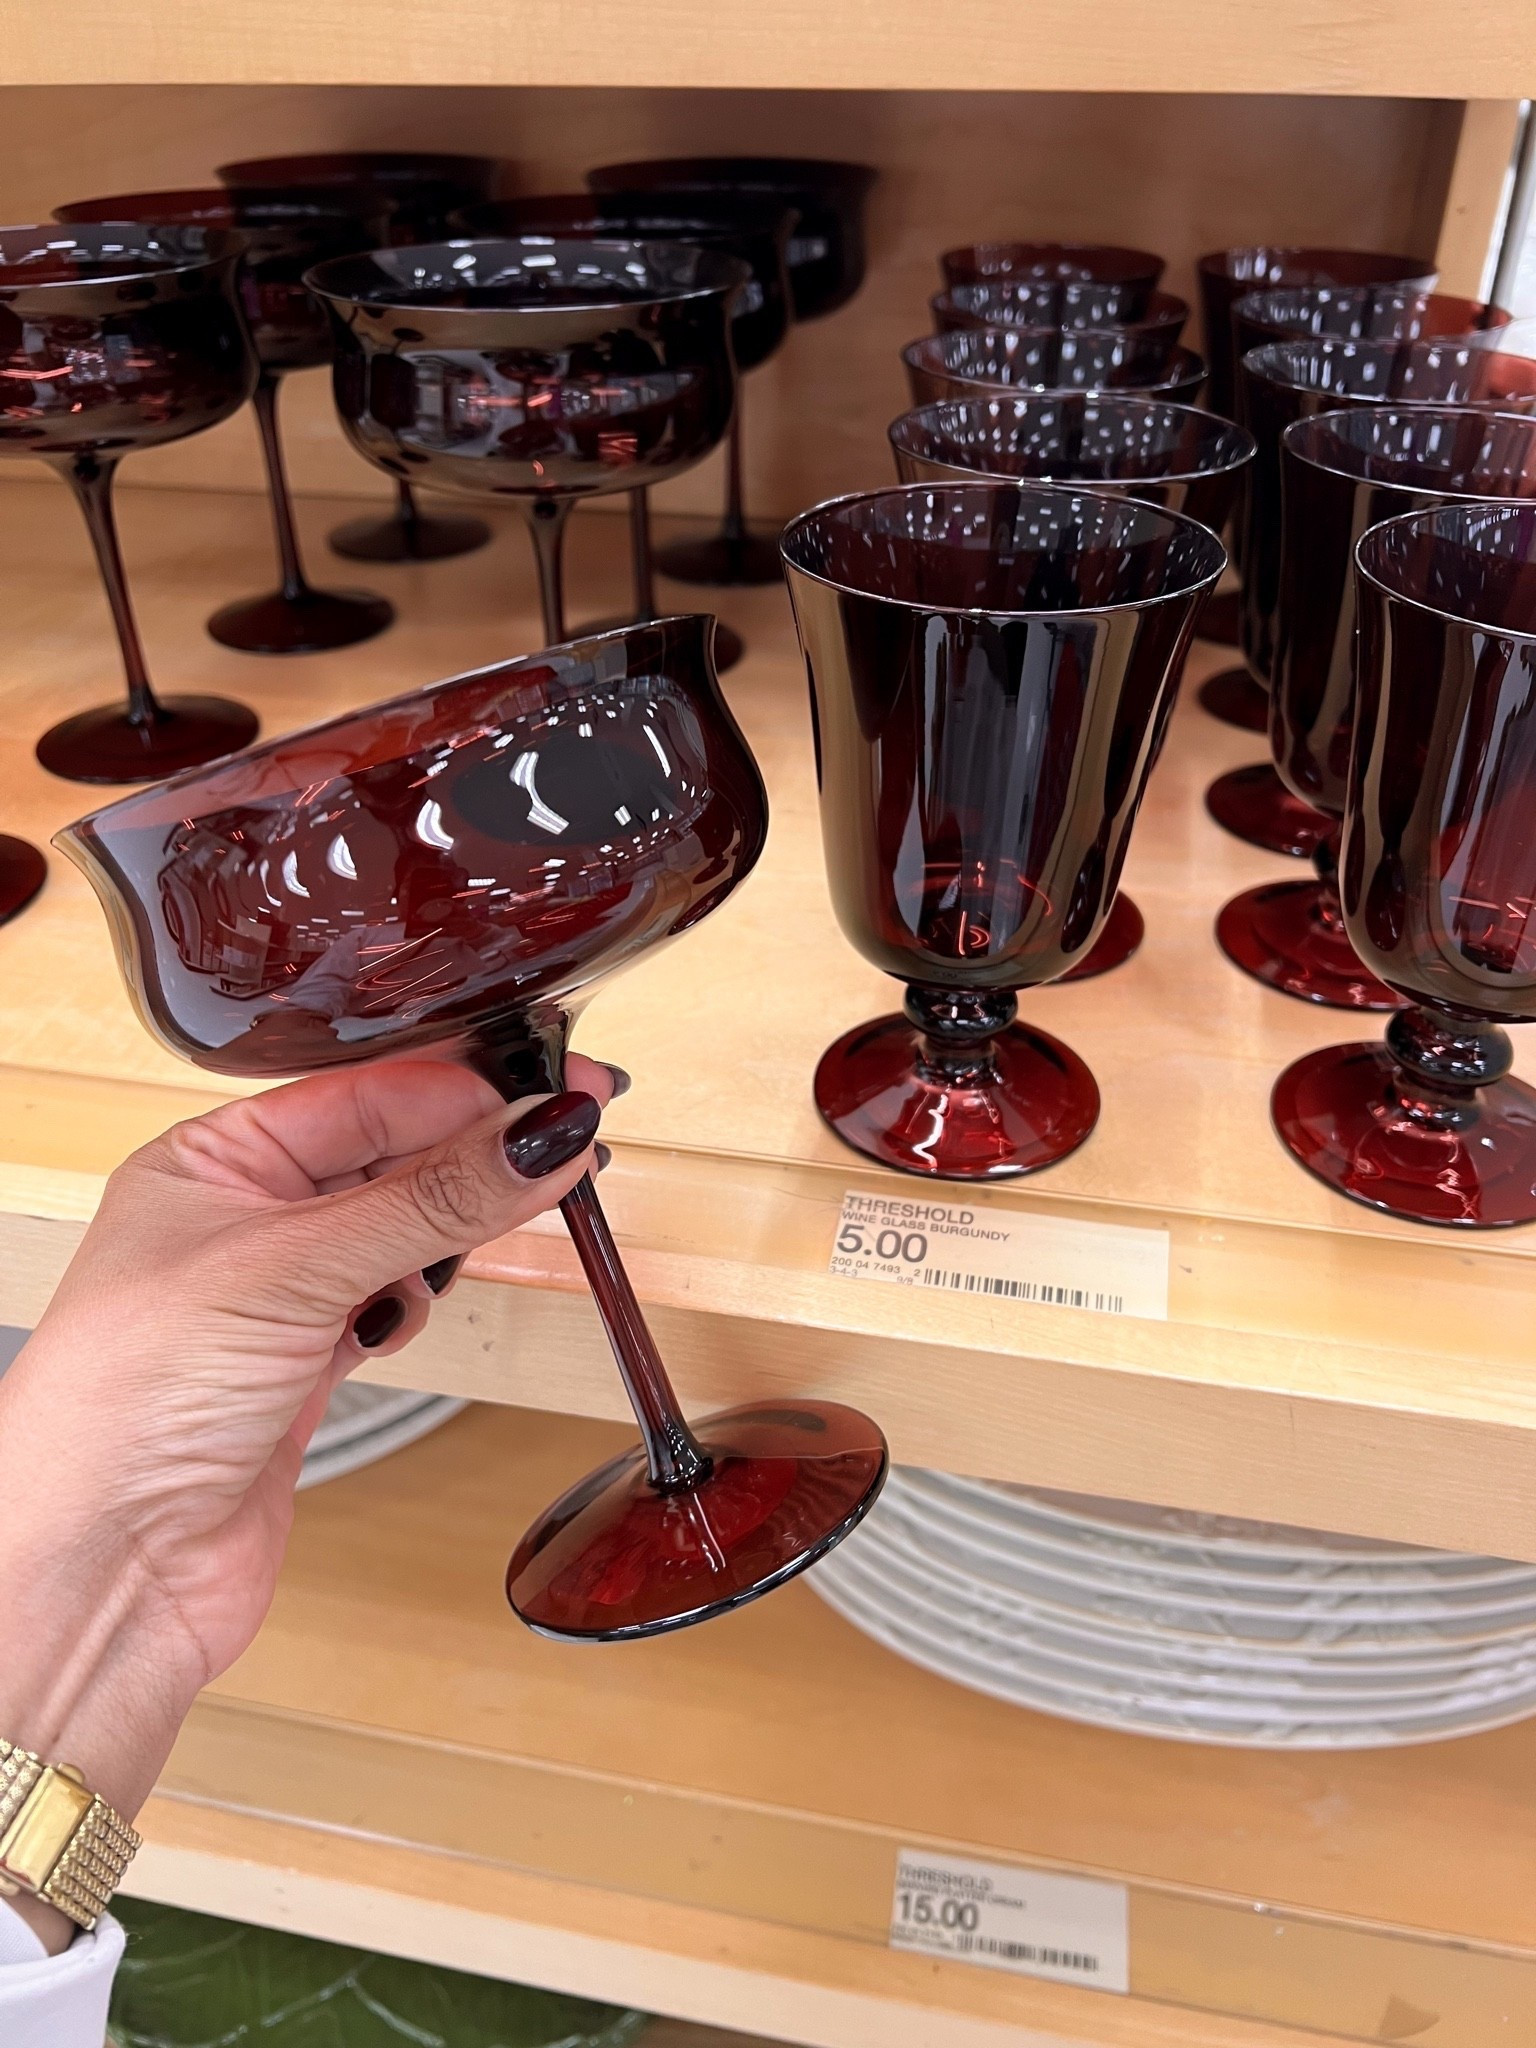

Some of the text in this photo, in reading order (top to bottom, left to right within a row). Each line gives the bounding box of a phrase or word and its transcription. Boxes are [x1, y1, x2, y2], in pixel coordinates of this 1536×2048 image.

[842, 1210, 1010, 1241] WINE GLASS BURGUNDY
[845, 1195, 974, 1225] THRESHOLD
[837, 1223, 928, 1263] 5.00
[832, 1256, 921, 1277] 200 04 7493 2
[899, 1894, 979, 1932] 15.00
